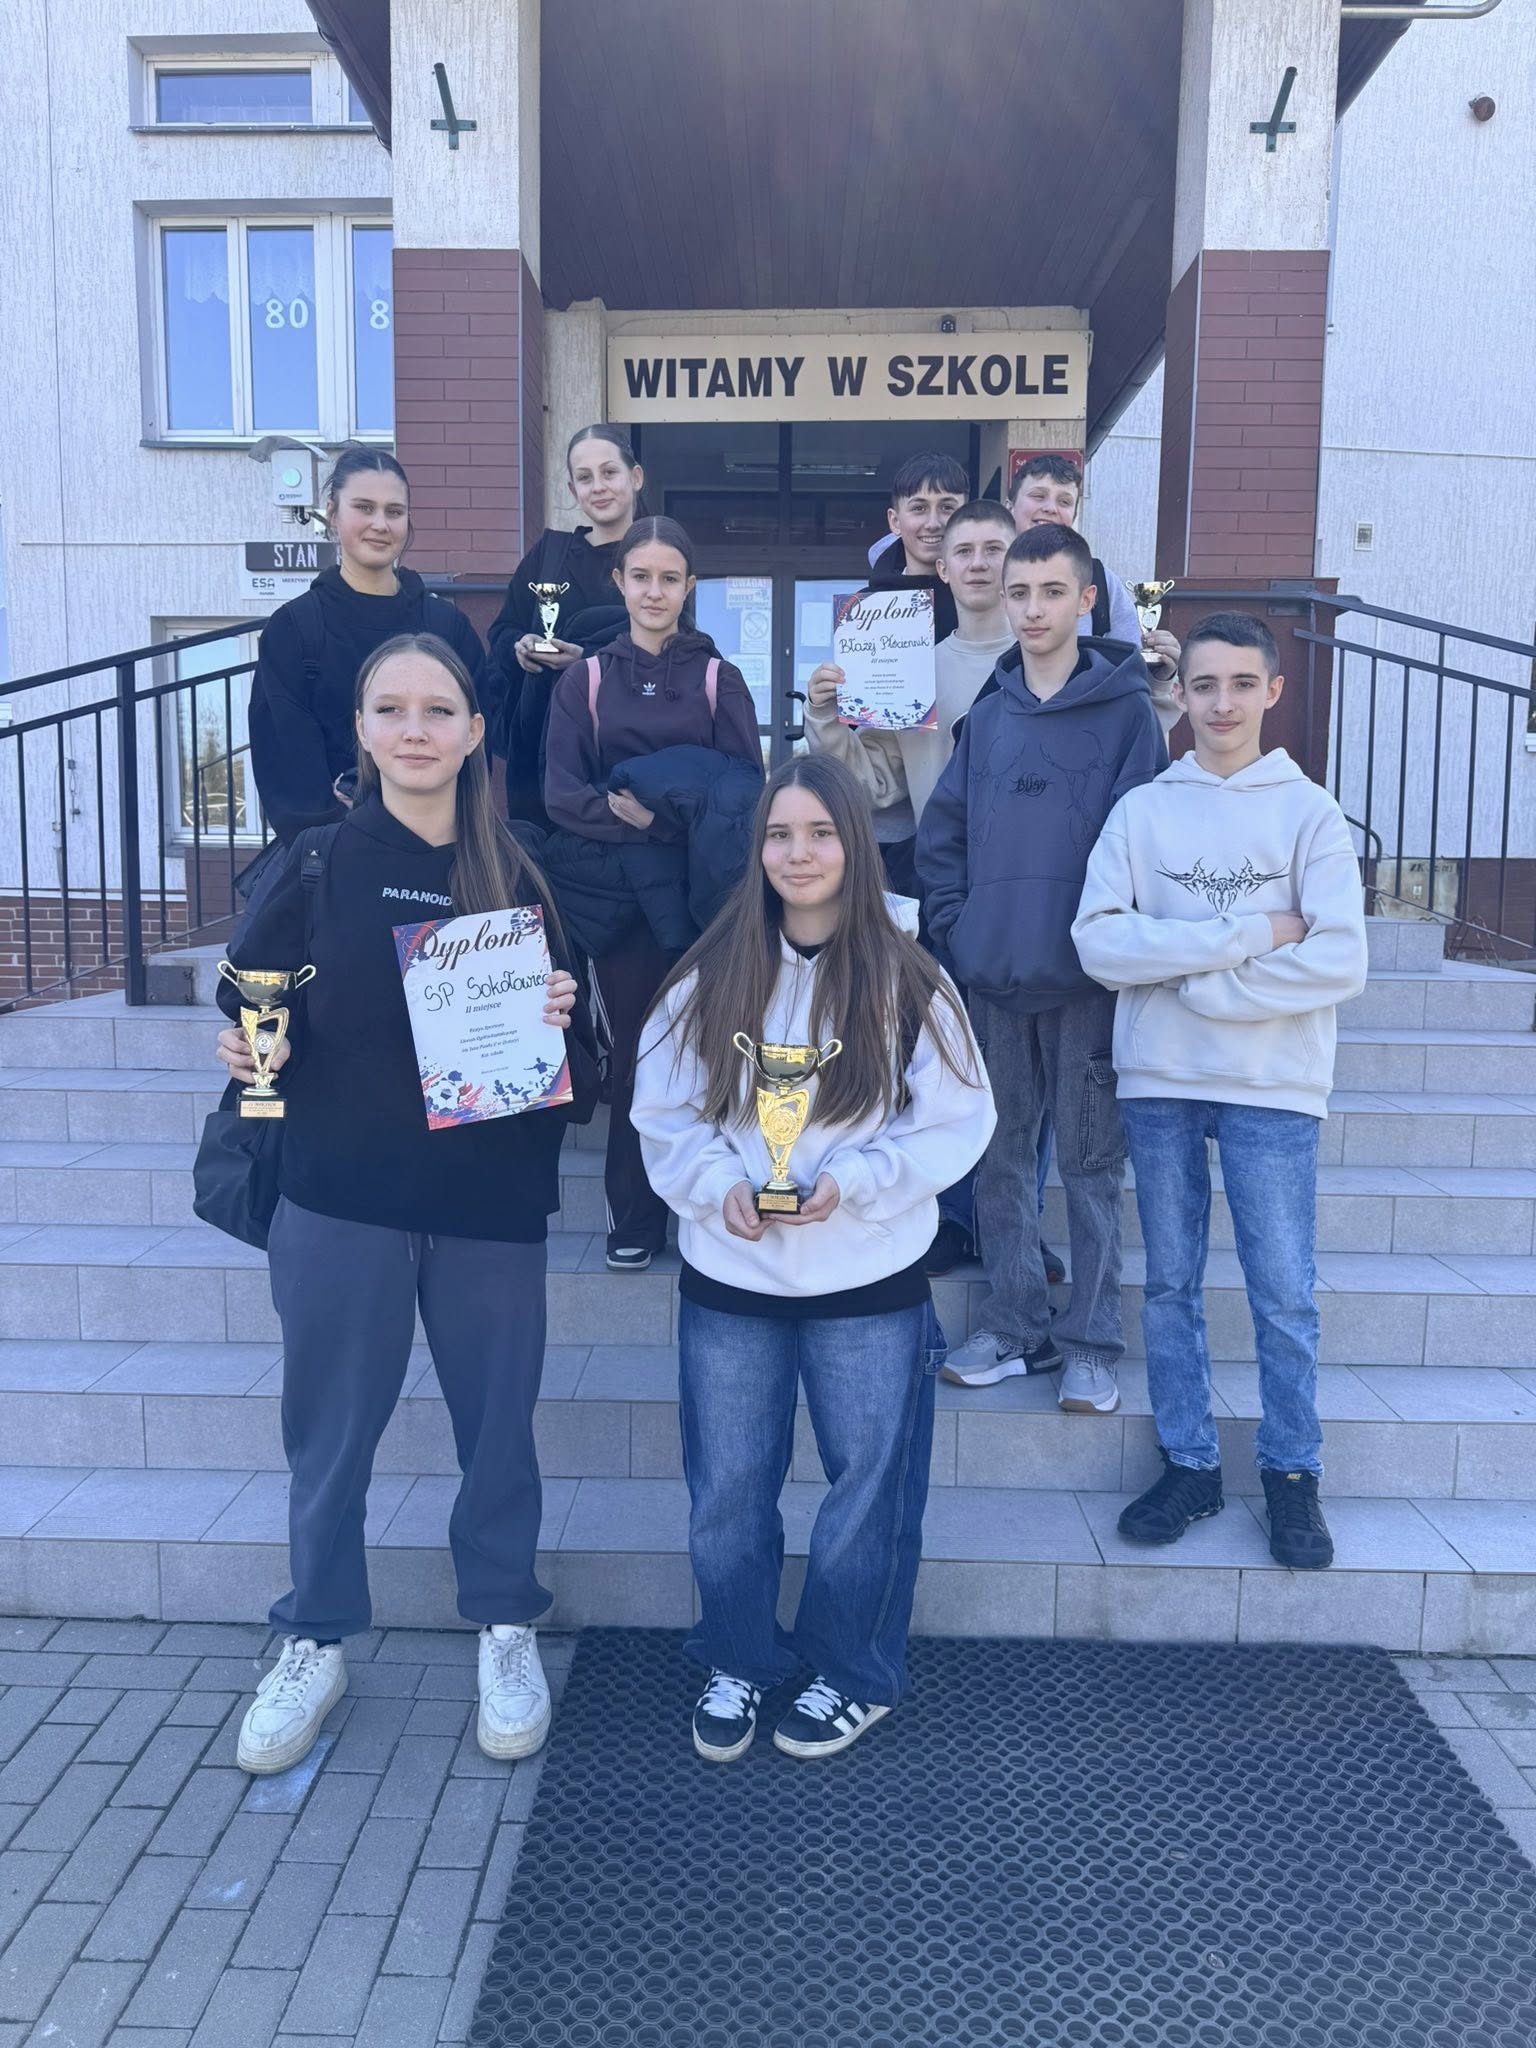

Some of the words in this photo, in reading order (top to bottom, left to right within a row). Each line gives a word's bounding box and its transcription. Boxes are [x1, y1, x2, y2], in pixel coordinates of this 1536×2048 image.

[265, 298, 309, 329] 80
[623, 356, 805, 398] WITAMY
[827, 356, 868, 396] W
[887, 354, 1069, 396] SZKOLE
[273, 544, 318, 568] STAN
[252, 577, 275, 588] ESA
[850, 596, 919, 631] Dyplom
[839, 637, 876, 656] Błażej
[382, 887, 453, 906] PARANOID
[424, 919, 523, 971] Dyplom
[424, 981, 455, 1012] SP
[473, 1002, 502, 1013] miejsce
[261, 1039, 268, 1048] 2
